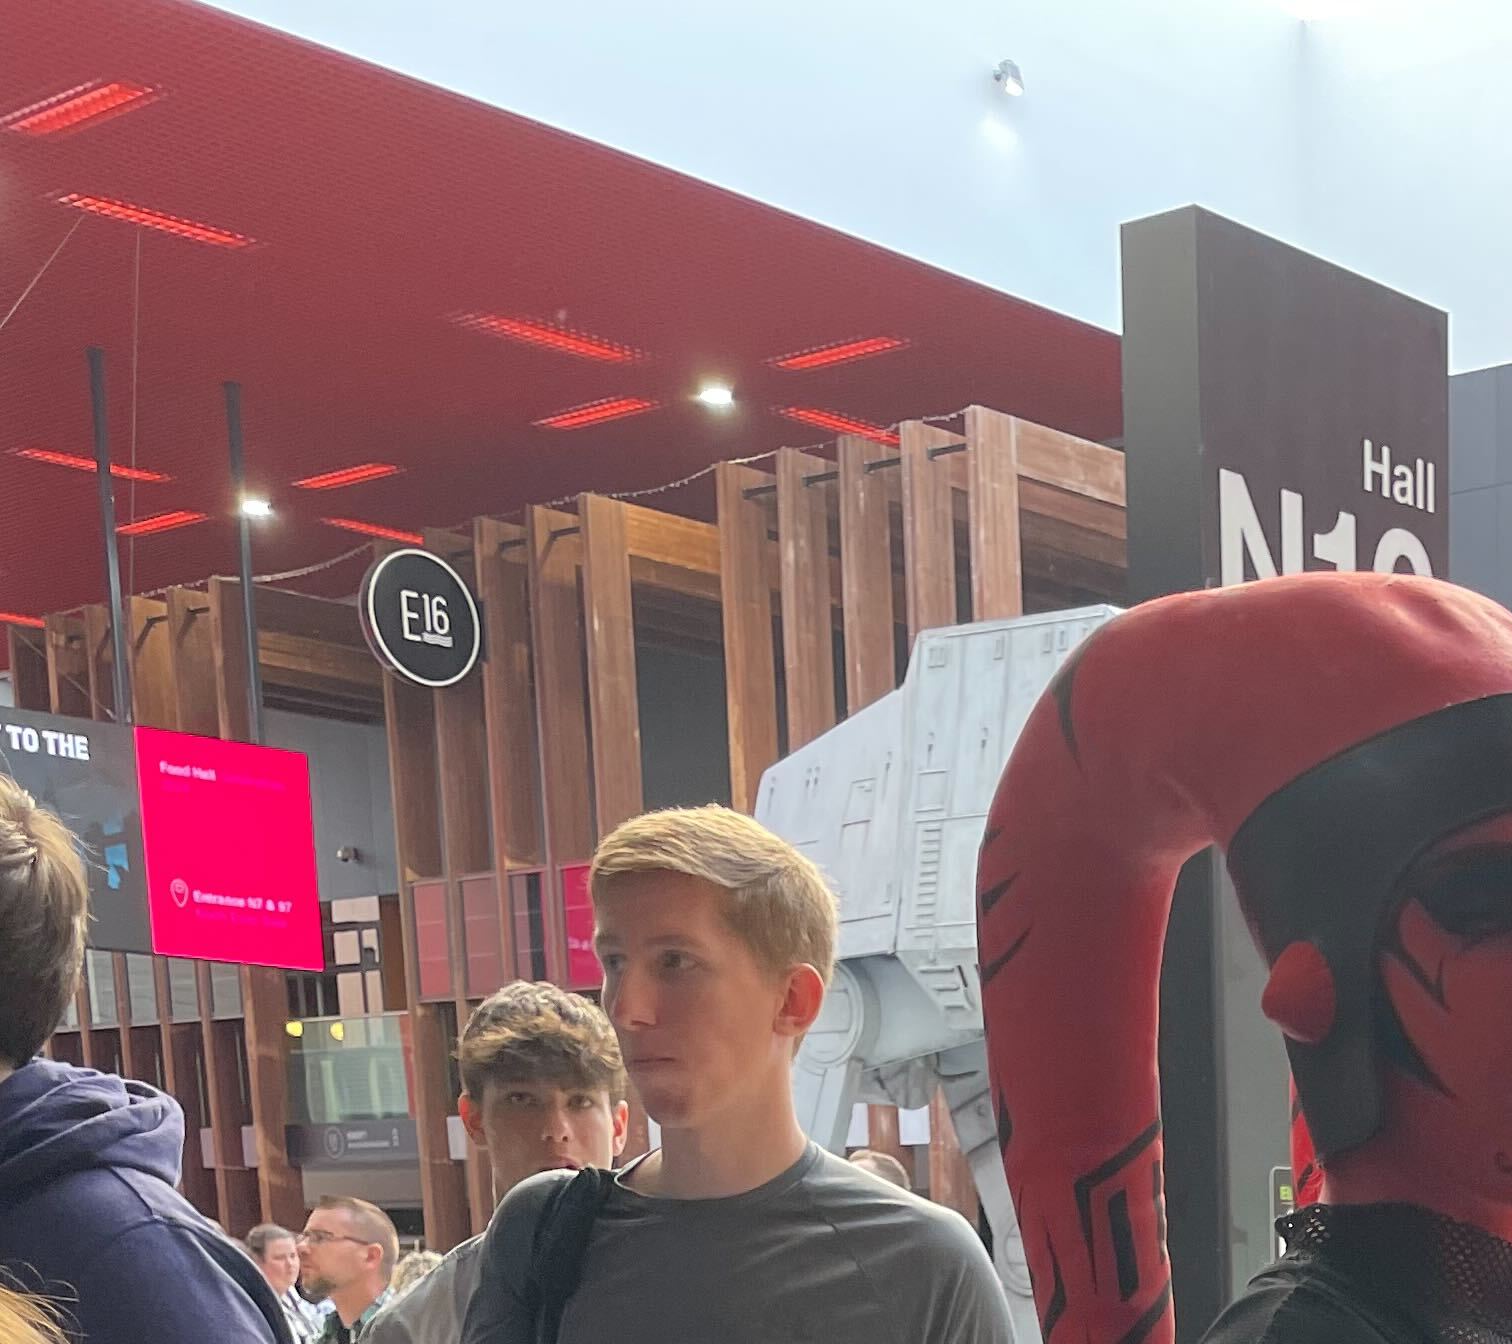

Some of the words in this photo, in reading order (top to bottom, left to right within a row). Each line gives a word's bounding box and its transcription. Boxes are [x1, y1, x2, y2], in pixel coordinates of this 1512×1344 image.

[1363, 438, 1435, 514] Hall
[400, 588, 451, 643] E16
[5, 723, 40, 753] TO
[41, 729, 90, 761] THE
